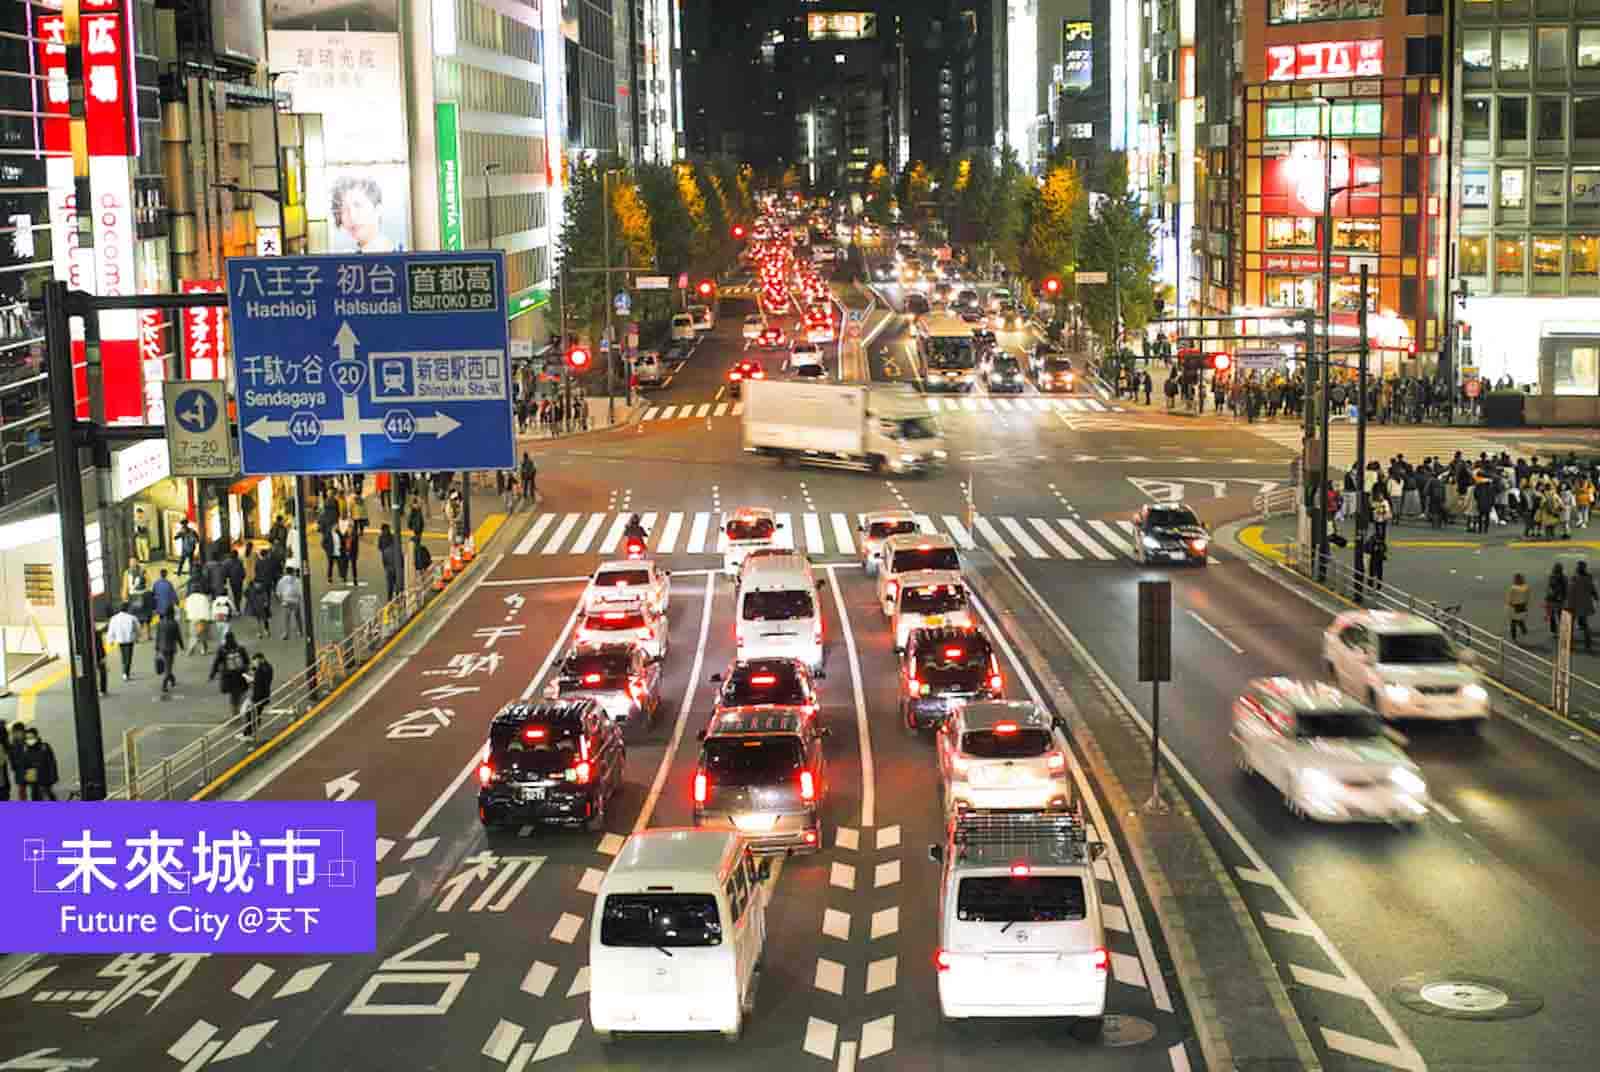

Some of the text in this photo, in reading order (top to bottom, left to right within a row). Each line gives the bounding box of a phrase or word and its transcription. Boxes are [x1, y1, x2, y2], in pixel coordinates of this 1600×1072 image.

[1268, 43, 1355, 80] アコム
[237, 265, 322, 297] 八王子
[337, 264, 396, 294] 初台
[413, 265, 491, 293] 首都高
[247, 301, 317, 319] Hachioji
[334, 299, 402, 315] Hatsudai
[412, 293, 492, 309] SHUTOKO EXP
[338, 367, 359, 385] 20
[416, 356, 500, 384] 新宿駅西口
[245, 389, 325, 409] Sendagaya
[418, 382, 465, 398] Shinjuku
[292, 420, 317, 436] 414
[387, 416, 412, 433] 414
[344, 851, 547, 1015] 初台
